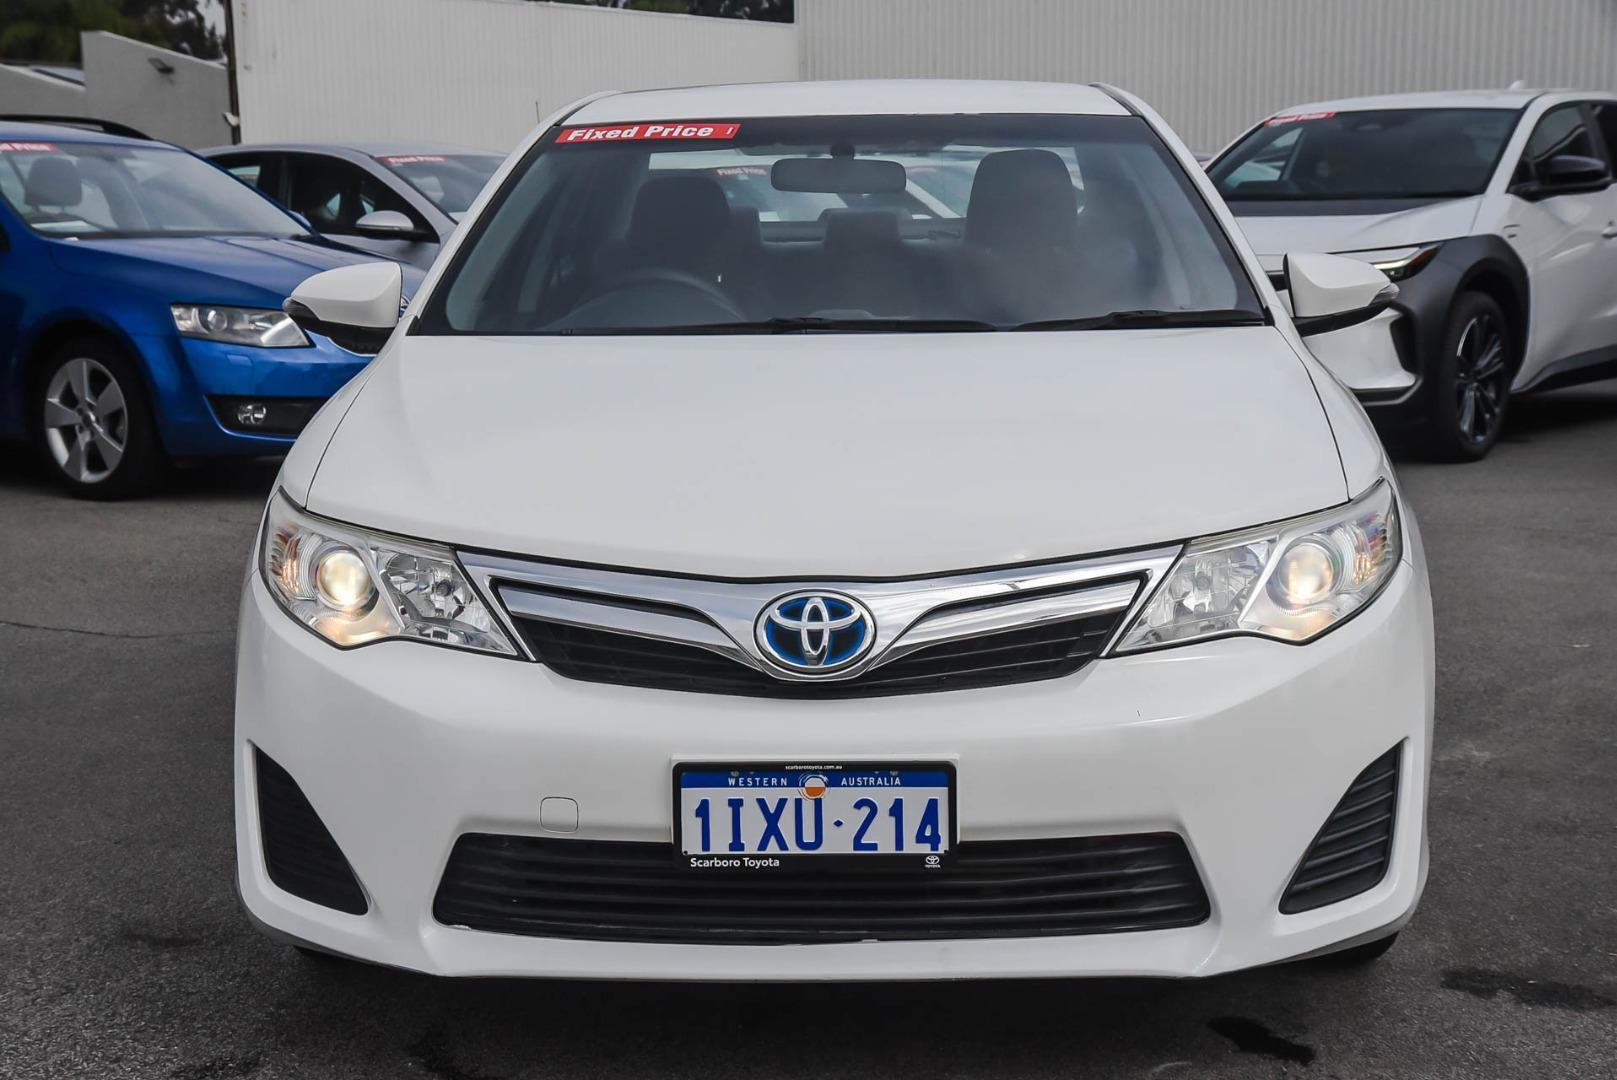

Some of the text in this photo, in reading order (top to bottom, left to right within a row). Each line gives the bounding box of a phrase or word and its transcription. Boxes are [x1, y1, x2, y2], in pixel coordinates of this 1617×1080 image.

[567, 125, 714, 141] Fixed Price
[728, 777, 902, 786] WESTERN AUSTRALIA
[690, 857, 780, 869] Scarboro Toyota
